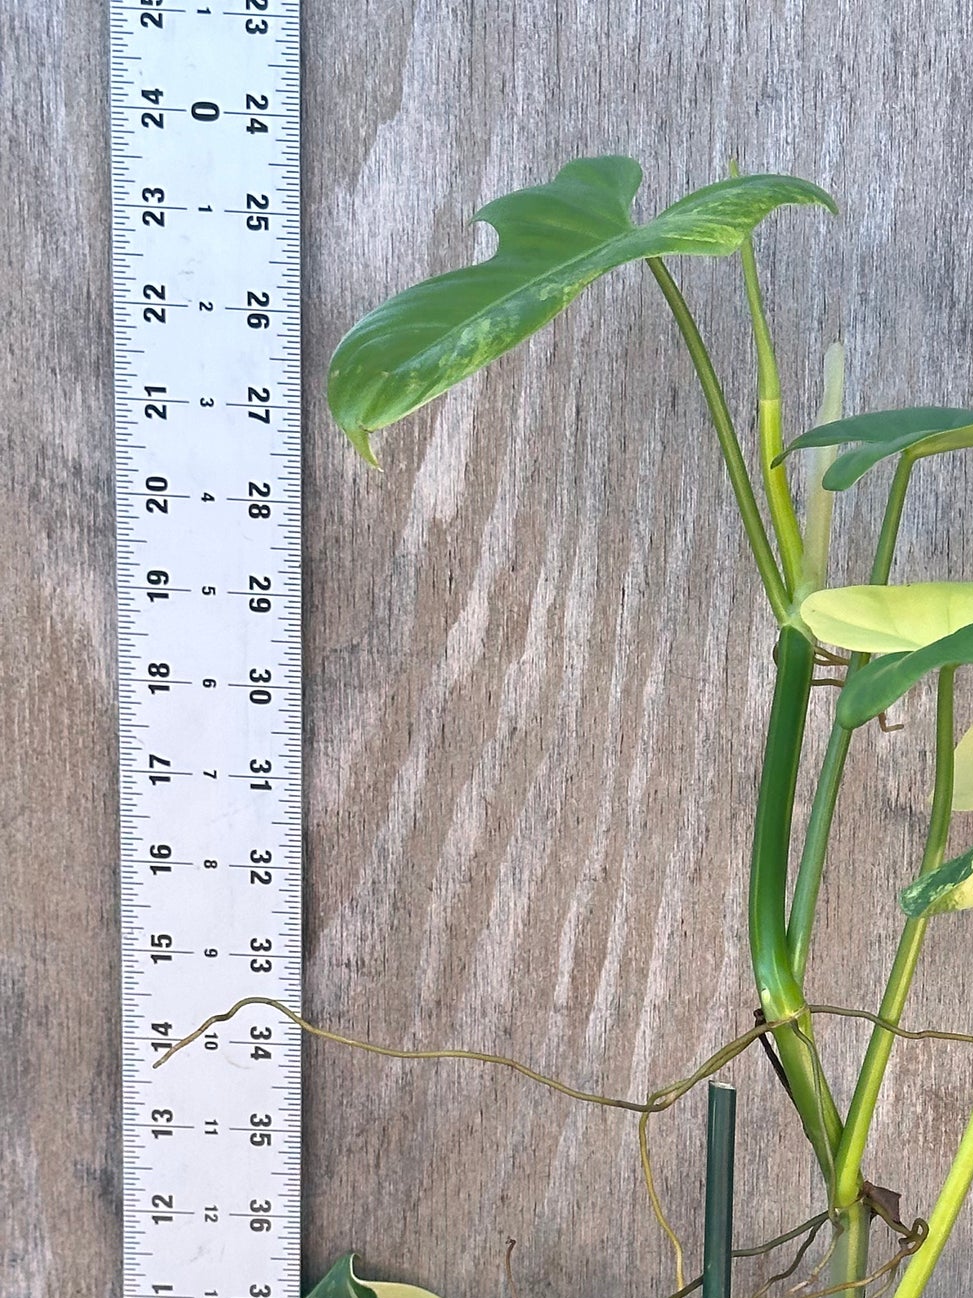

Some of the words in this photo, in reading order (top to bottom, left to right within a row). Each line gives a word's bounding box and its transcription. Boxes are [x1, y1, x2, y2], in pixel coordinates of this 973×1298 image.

[196, 6, 212, 15] 1
[244, 0, 269, 35] 23
[140, 87, 165, 130] 24
[190, 101, 221, 123] 0
[245, 93, 270, 135] 24
[141, 187, 166, 228] 23
[197, 204, 214, 213] 1
[245, 192, 270, 232] 25
[142, 283, 167, 324] 22
[198, 301, 214, 312] 2
[246, 290, 270, 330] 26
[143, 385, 168, 421] 21
[199, 397, 215, 408] 3
[247, 386, 271, 425] 27
[145, 476, 169, 515] 20
[200, 491, 216, 503] 4
[248, 481, 272, 520] 28
[146, 569, 170, 603] 19
[201, 585, 217, 596] 5
[248, 574, 272, 614] 29
[147, 662, 171, 696] 18
[202, 678, 217, 689] 6
[248, 667, 272, 705] 30
[148, 753, 172, 787] 17
[202, 769, 218, 780] 7
[249, 758, 273, 791] 31
[149, 844, 172, 876] 16
[203, 859, 218, 870] 8
[249, 849, 273, 886] 32
[150, 933, 173, 965] 15
[203, 948, 219, 959] 9
[249, 937, 273, 973] 33
[150, 1021, 173, 1053] 14
[204, 1032, 219, 1051] 10
[249, 1025, 273, 1061] 34
[151, 1108, 174, 1140] 13
[204, 1118, 219, 1136] 11
[249, 1113, 272, 1147] 35
[151, 1194, 174, 1226] 12
[204, 1204, 219, 1223] 12
[249, 1199, 272, 1233] 36
